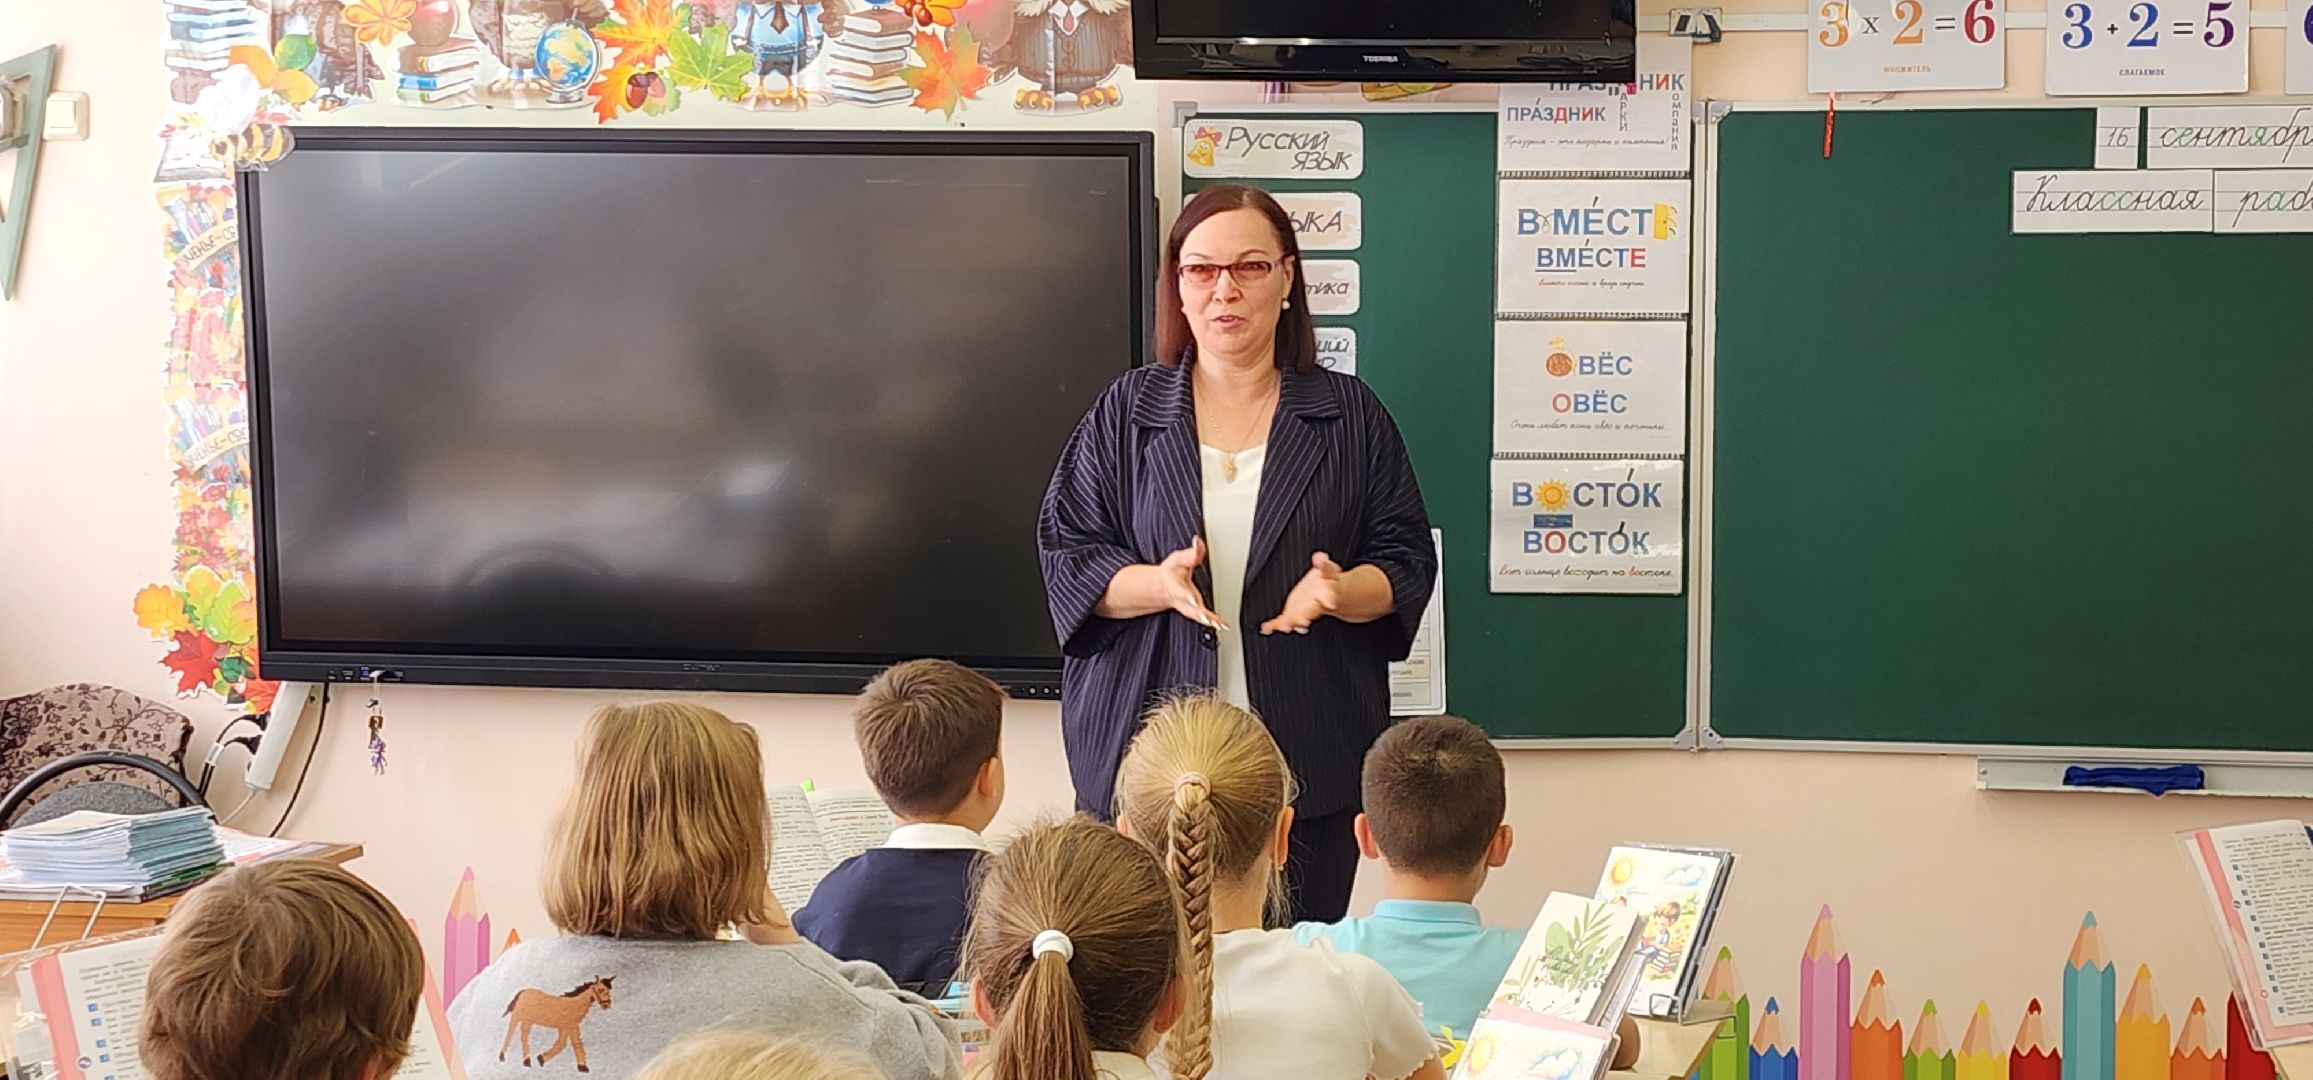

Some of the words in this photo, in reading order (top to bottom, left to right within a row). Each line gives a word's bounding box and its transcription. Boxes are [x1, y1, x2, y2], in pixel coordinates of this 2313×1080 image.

[1819, 1, 1849, 47] 3
[1892, 0, 1923, 45] 2
[1964, 0, 1995, 44] 6
[2062, 3, 2093, 49] 3
[2126, 1, 2160, 48] 2
[2203, 1, 2234, 48] 5
[1225, 127, 1330, 157] Русский
[2107, 127, 2131, 147] 16
[2160, 107, 2313, 163] сентябр
[2026, 174, 2204, 211] Классная
[2232, 180, 2313, 228] раб
[1552, 390, 1628, 413] ОВЁС
